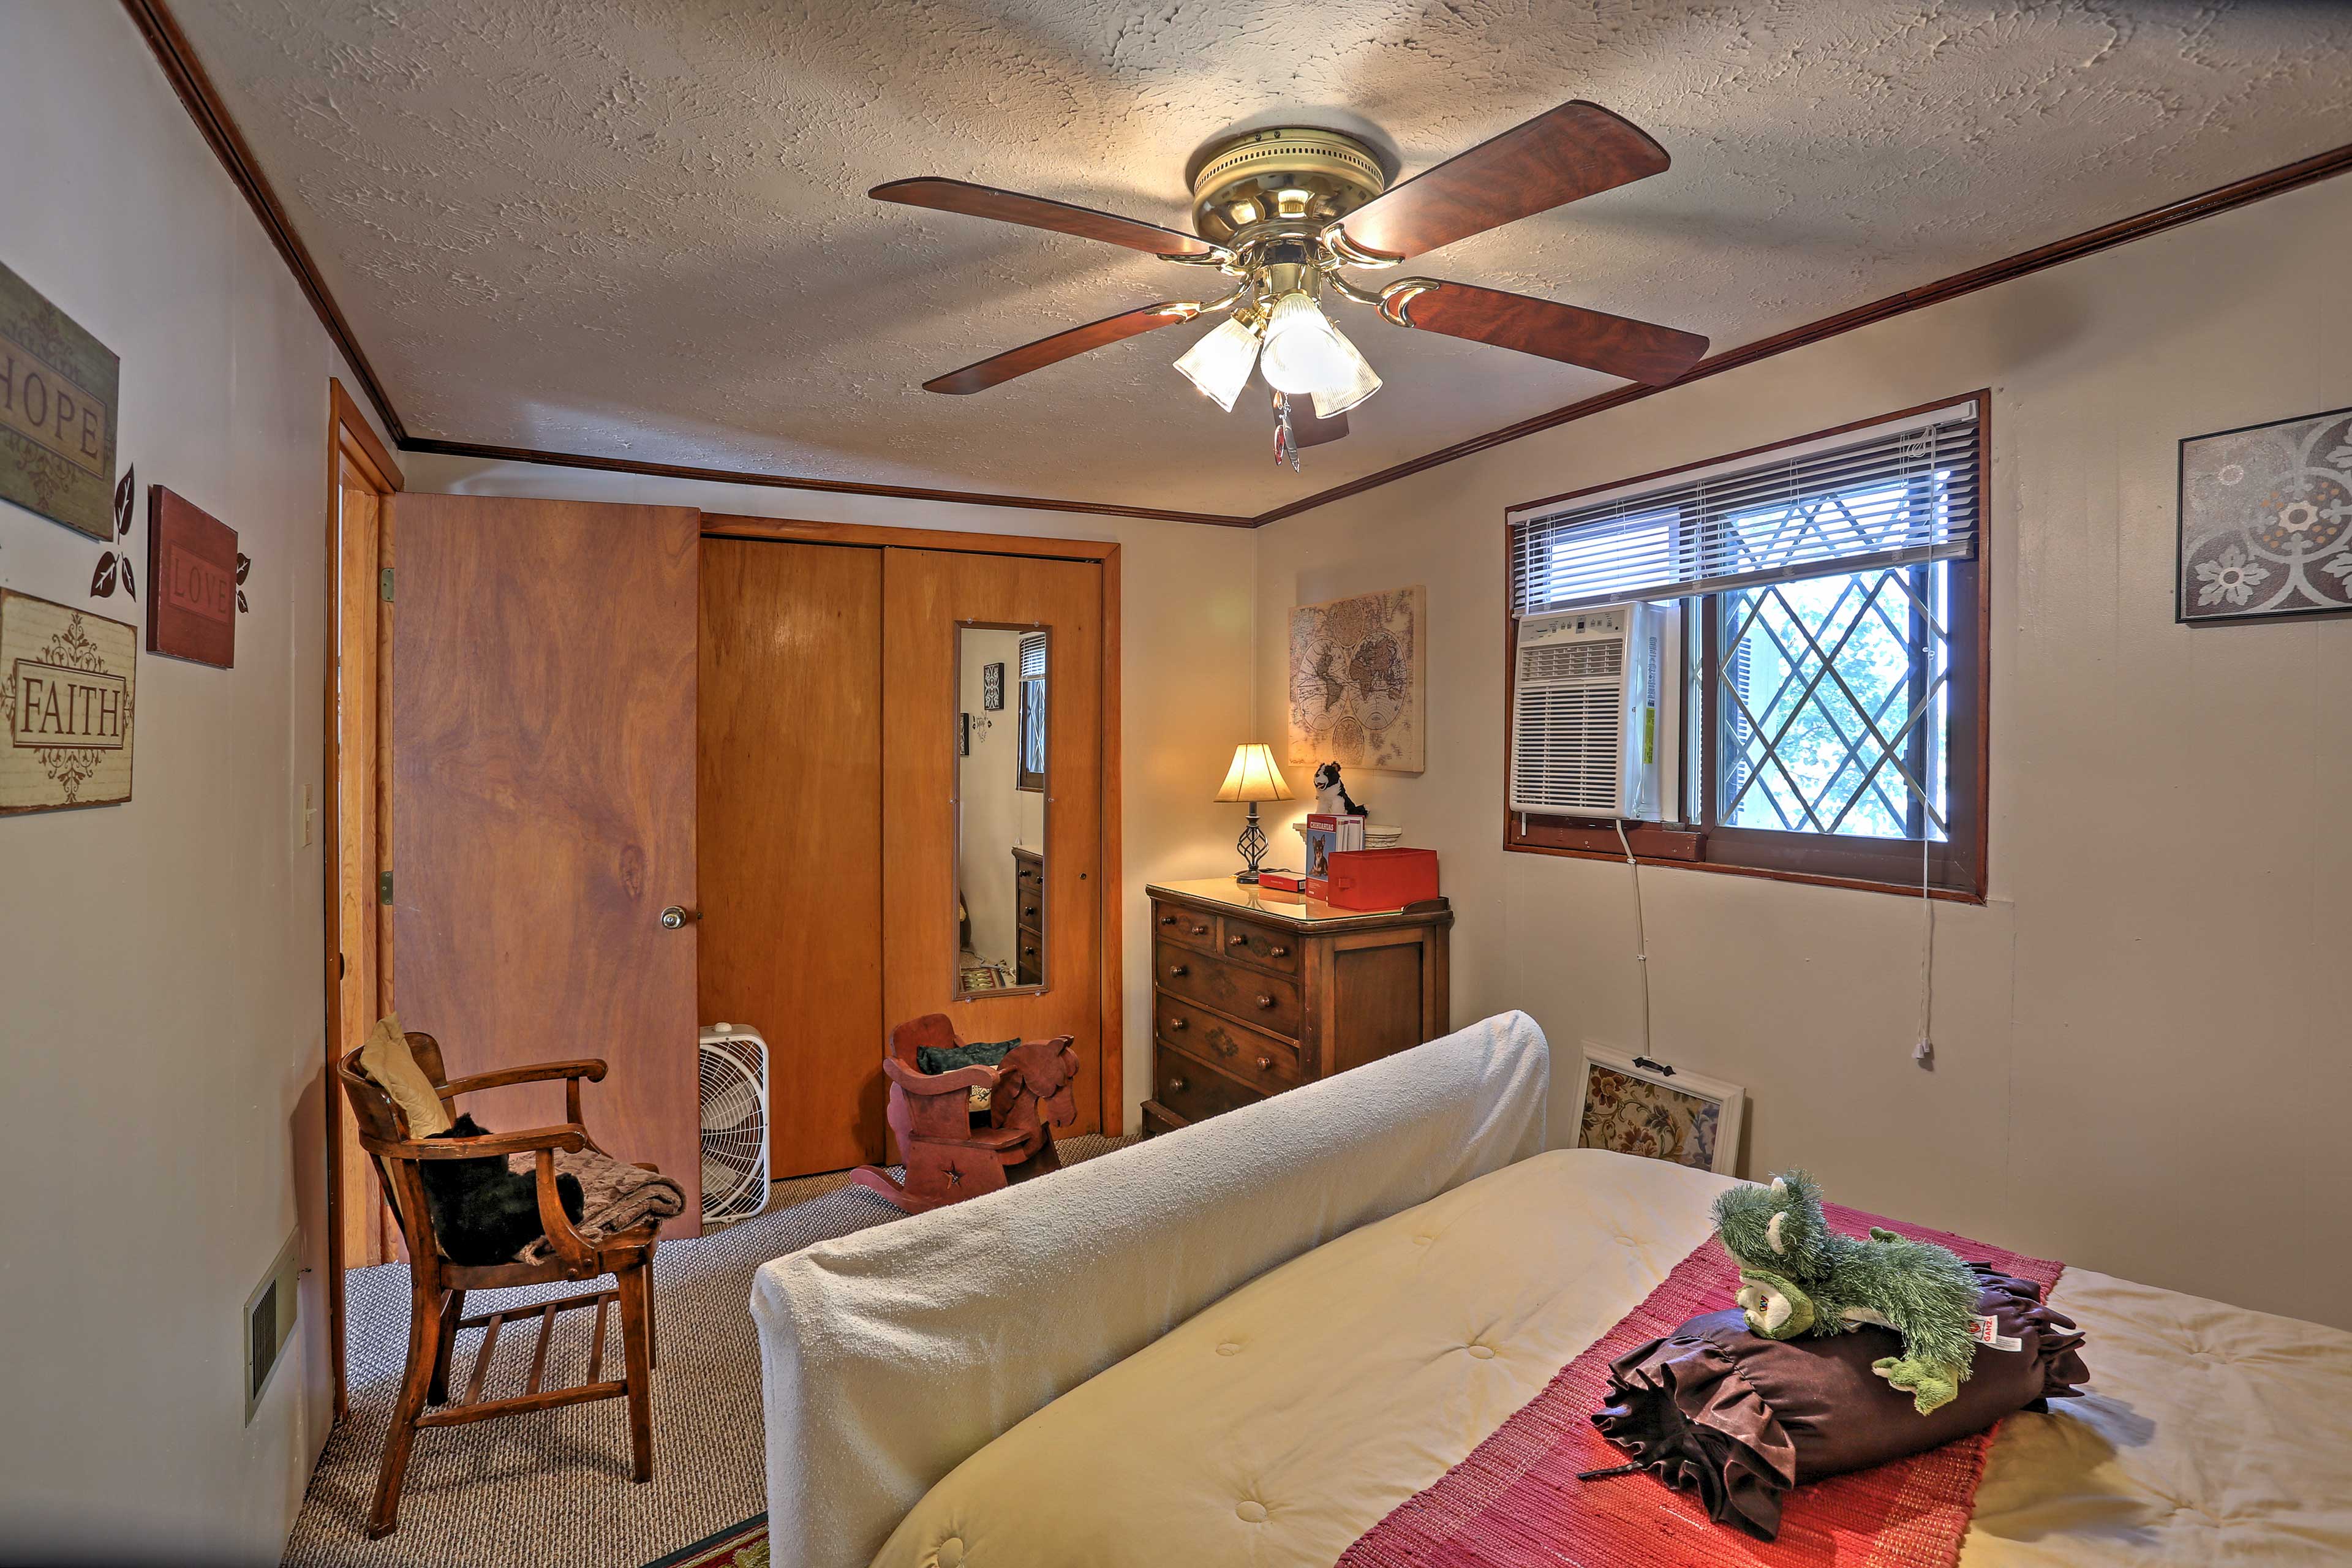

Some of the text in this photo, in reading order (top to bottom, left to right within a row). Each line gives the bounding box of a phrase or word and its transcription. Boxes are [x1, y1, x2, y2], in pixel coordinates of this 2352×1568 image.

[174, 558, 227, 614] LOVE
[20, 677, 120, 737] FAITH
[1984, 1321, 1992, 1341] GANZ
